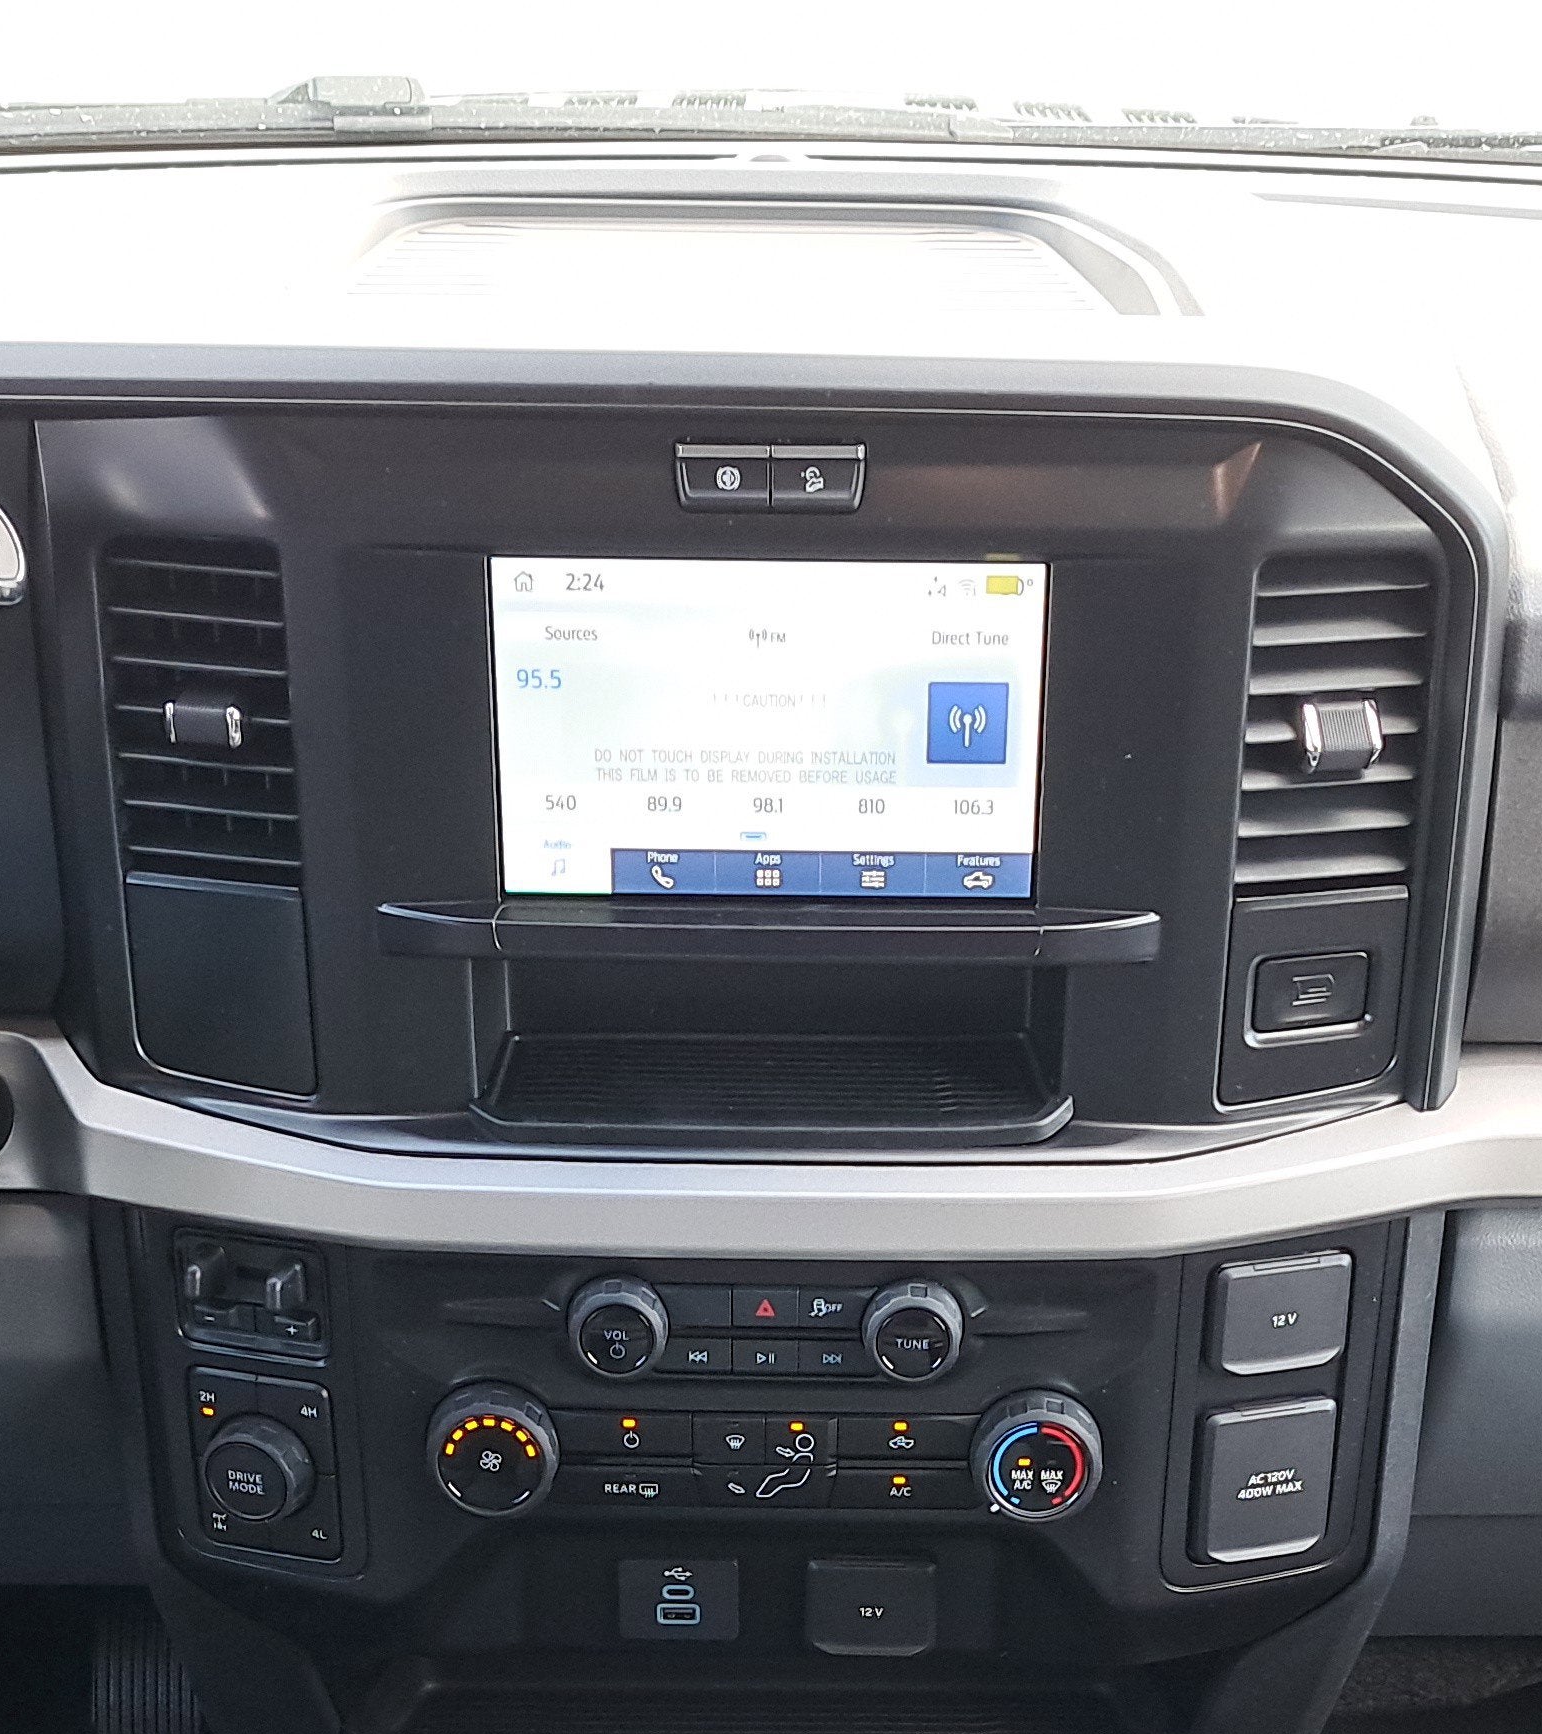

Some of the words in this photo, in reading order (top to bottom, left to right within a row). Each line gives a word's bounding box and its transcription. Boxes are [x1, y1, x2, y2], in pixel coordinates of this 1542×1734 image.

[565, 573, 604, 592] 2:24
[545, 626, 597, 641] Sources
[770, 632, 786, 643] FM
[931, 630, 970, 645] Direct
[975, 631, 1009, 646] Tune
[516, 669, 562, 690] 95.5
[743, 694, 796, 708] CAUTION
[594, 749, 612, 762] DO
[619, 749, 644, 763] NOT
[651, 750, 693, 763] TOUCH
[700, 750, 749, 764] DISPLAY
[758, 751, 804, 764] DURING
[811, 751, 896, 765] INSTALLATION
[595, 768, 622, 782] THIS
[630, 768, 658, 782] FILM
[664, 768, 676, 782] IS
[684, 769, 699, 782] TO
[707, 769, 723, 783] BE
[731, 769, 791, 783] REMOVED
[799, 770, 847, 784] BEFORE
[855, 771, 897, 785] USAGE
[545, 795, 577, 811] 540
[647, 796, 682, 813] 89.9
[753, 797, 783, 814] 98.1
[858, 798, 886, 815] 810
[953, 799, 994, 816] 106.3
[647, 851, 679, 864] Phone
[754, 853, 781, 867] Apps
[852, 853, 895, 867] Settings
[957, 854, 1001, 868] Features
[825, 1302, 843, 1313] OFF
[1272, 1314, 1286, 1328] 12
[604, 1330, 630, 1341] VOL
[896, 1338, 930, 1350] TUNE
[199, 1391, 216, 1403] 2H
[300, 1405, 318, 1418] 4H
[228, 1469, 263, 1484] DRIVE
[1011, 1469, 1034, 1480] MAX
[1040, 1469, 1063, 1480] MAX
[1247, 1474, 1267, 1487] AC
[1267, 1468, 1297, 1484] 120V
[229, 1481, 265, 1495] MODE
[605, 1484, 637, 1494] REAR
[889, 1485, 912, 1497] A/C
[1014, 1479, 1032, 1491] A/C
[1237, 1485, 1274, 1500] 400W
[1276, 1480, 1304, 1495] MAX
[311, 1529, 328, 1540] 4L
[859, 1607, 873, 1617] 12
